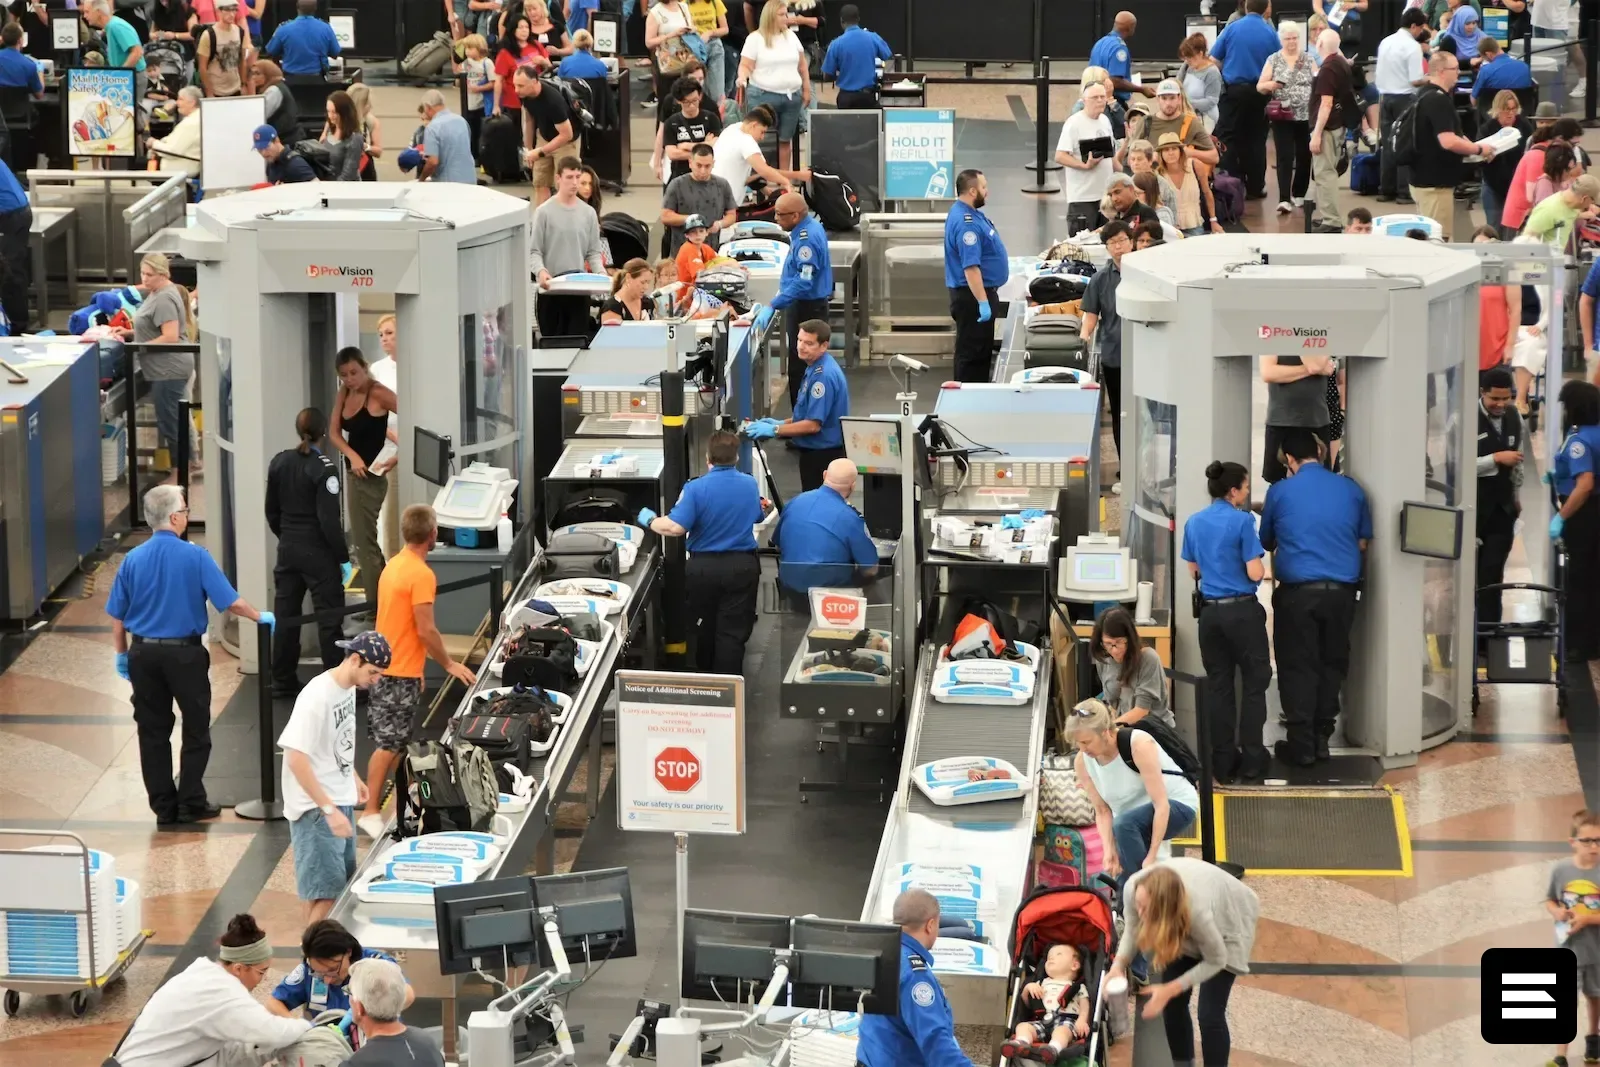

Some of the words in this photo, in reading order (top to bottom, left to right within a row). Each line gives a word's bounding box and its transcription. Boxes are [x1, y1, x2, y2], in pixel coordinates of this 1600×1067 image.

[72, 74, 90, 83] Mail
[92, 75, 98, 83] It
[101, 76, 128, 84] Home
[891, 136, 930, 147] HOLD
[934, 136, 946, 147] IT
[891, 149, 932, 159] REFILL
[935, 149, 946, 159] IT
[351, 277, 374, 287] ATD
[668, 325, 675, 340] 5
[1302, 338, 1327, 348] ATD
[902, 401, 909, 417] 6
[825, 602, 856, 614] STOP
[655, 687, 689, 695] Additional
[690, 688, 721, 698] Screening
[676, 726, 706, 734] REMOVE
[657, 761, 698, 778] STOP
[633, 799, 649, 807] Your
[650, 801, 673, 809] safety
[695, 803, 724, 811] priority
